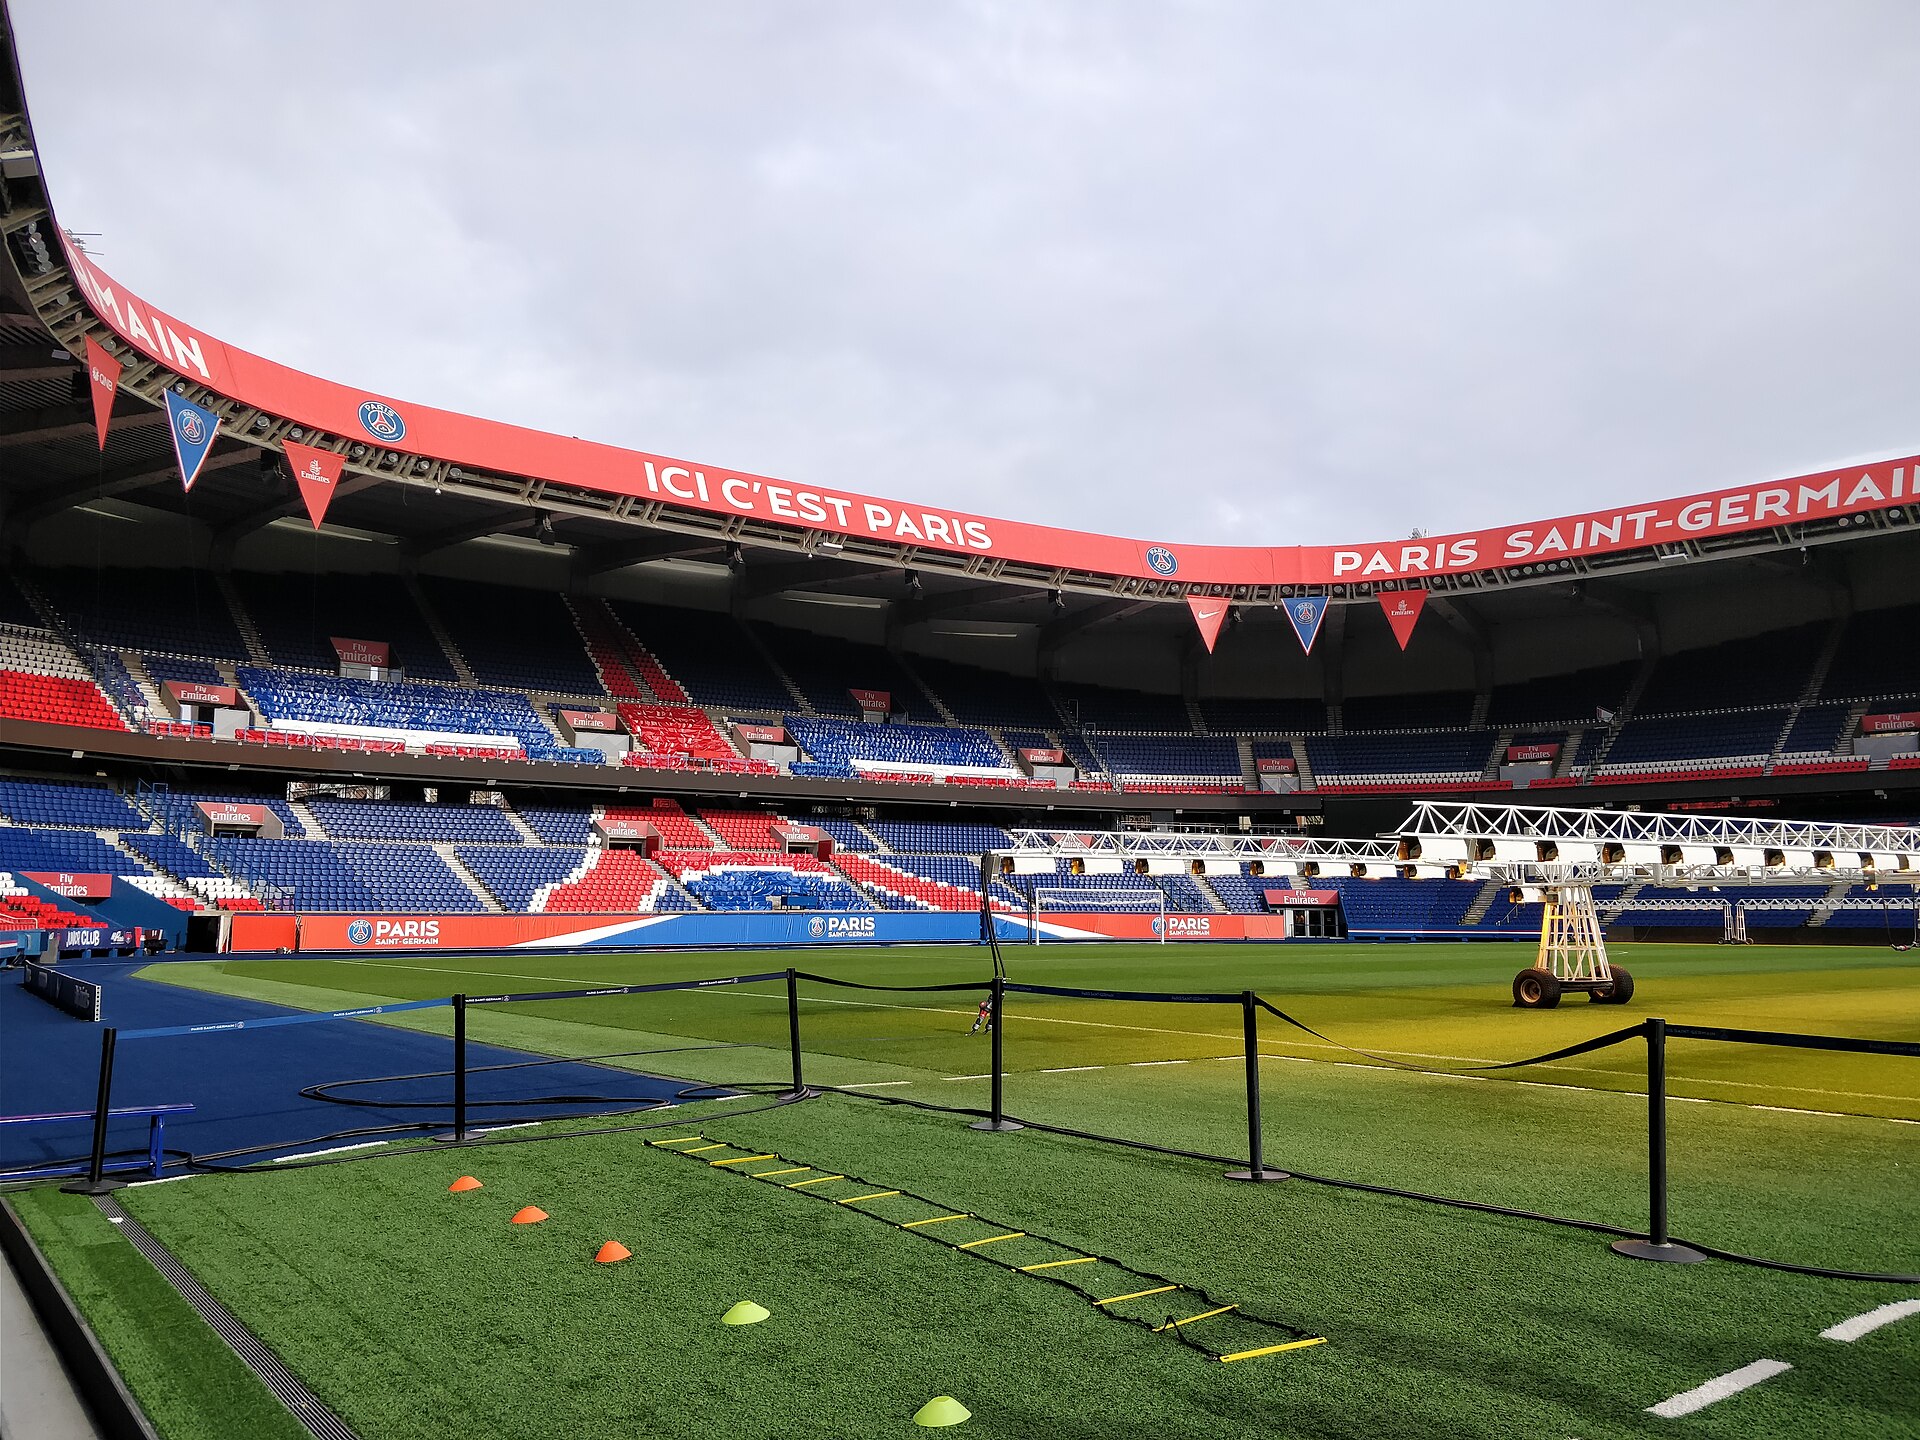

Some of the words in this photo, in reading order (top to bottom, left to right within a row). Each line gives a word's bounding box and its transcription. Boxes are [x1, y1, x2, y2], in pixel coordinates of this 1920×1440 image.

[364, 403, 395, 417] PARIS
[301, 470, 331, 484] Emirates
[643, 461, 710, 502] ICI
[720, 478, 852, 526] C'EST
[863, 502, 994, 550] PARIS
[1333, 538, 1479, 577] PARIS
[1503, 464, 1920, 559] SAINT-GERMAI
[1391, 608, 1415, 617] Emirates
[181, 690, 221, 702] Emirates
[573, 717, 604, 727] Emirates
[1875, 719, 1916, 730] Emirates
[746, 731, 774, 740] Emirates
[1030, 754, 1055, 762] Emirates
[1517, 750, 1551, 760] Emirates
[210, 810, 251, 821] Emirates
[606, 825, 638, 836] Emirates
[1283, 895, 1319, 905] Emirates
[376, 920, 440, 937] PARIS
[828, 917, 875, 931] PARIS
[1169, 917, 1210, 930] PARIS
[80, 930, 100, 946] CLUB
[375, 937, 438, 945] SAINT-GERMAIN
